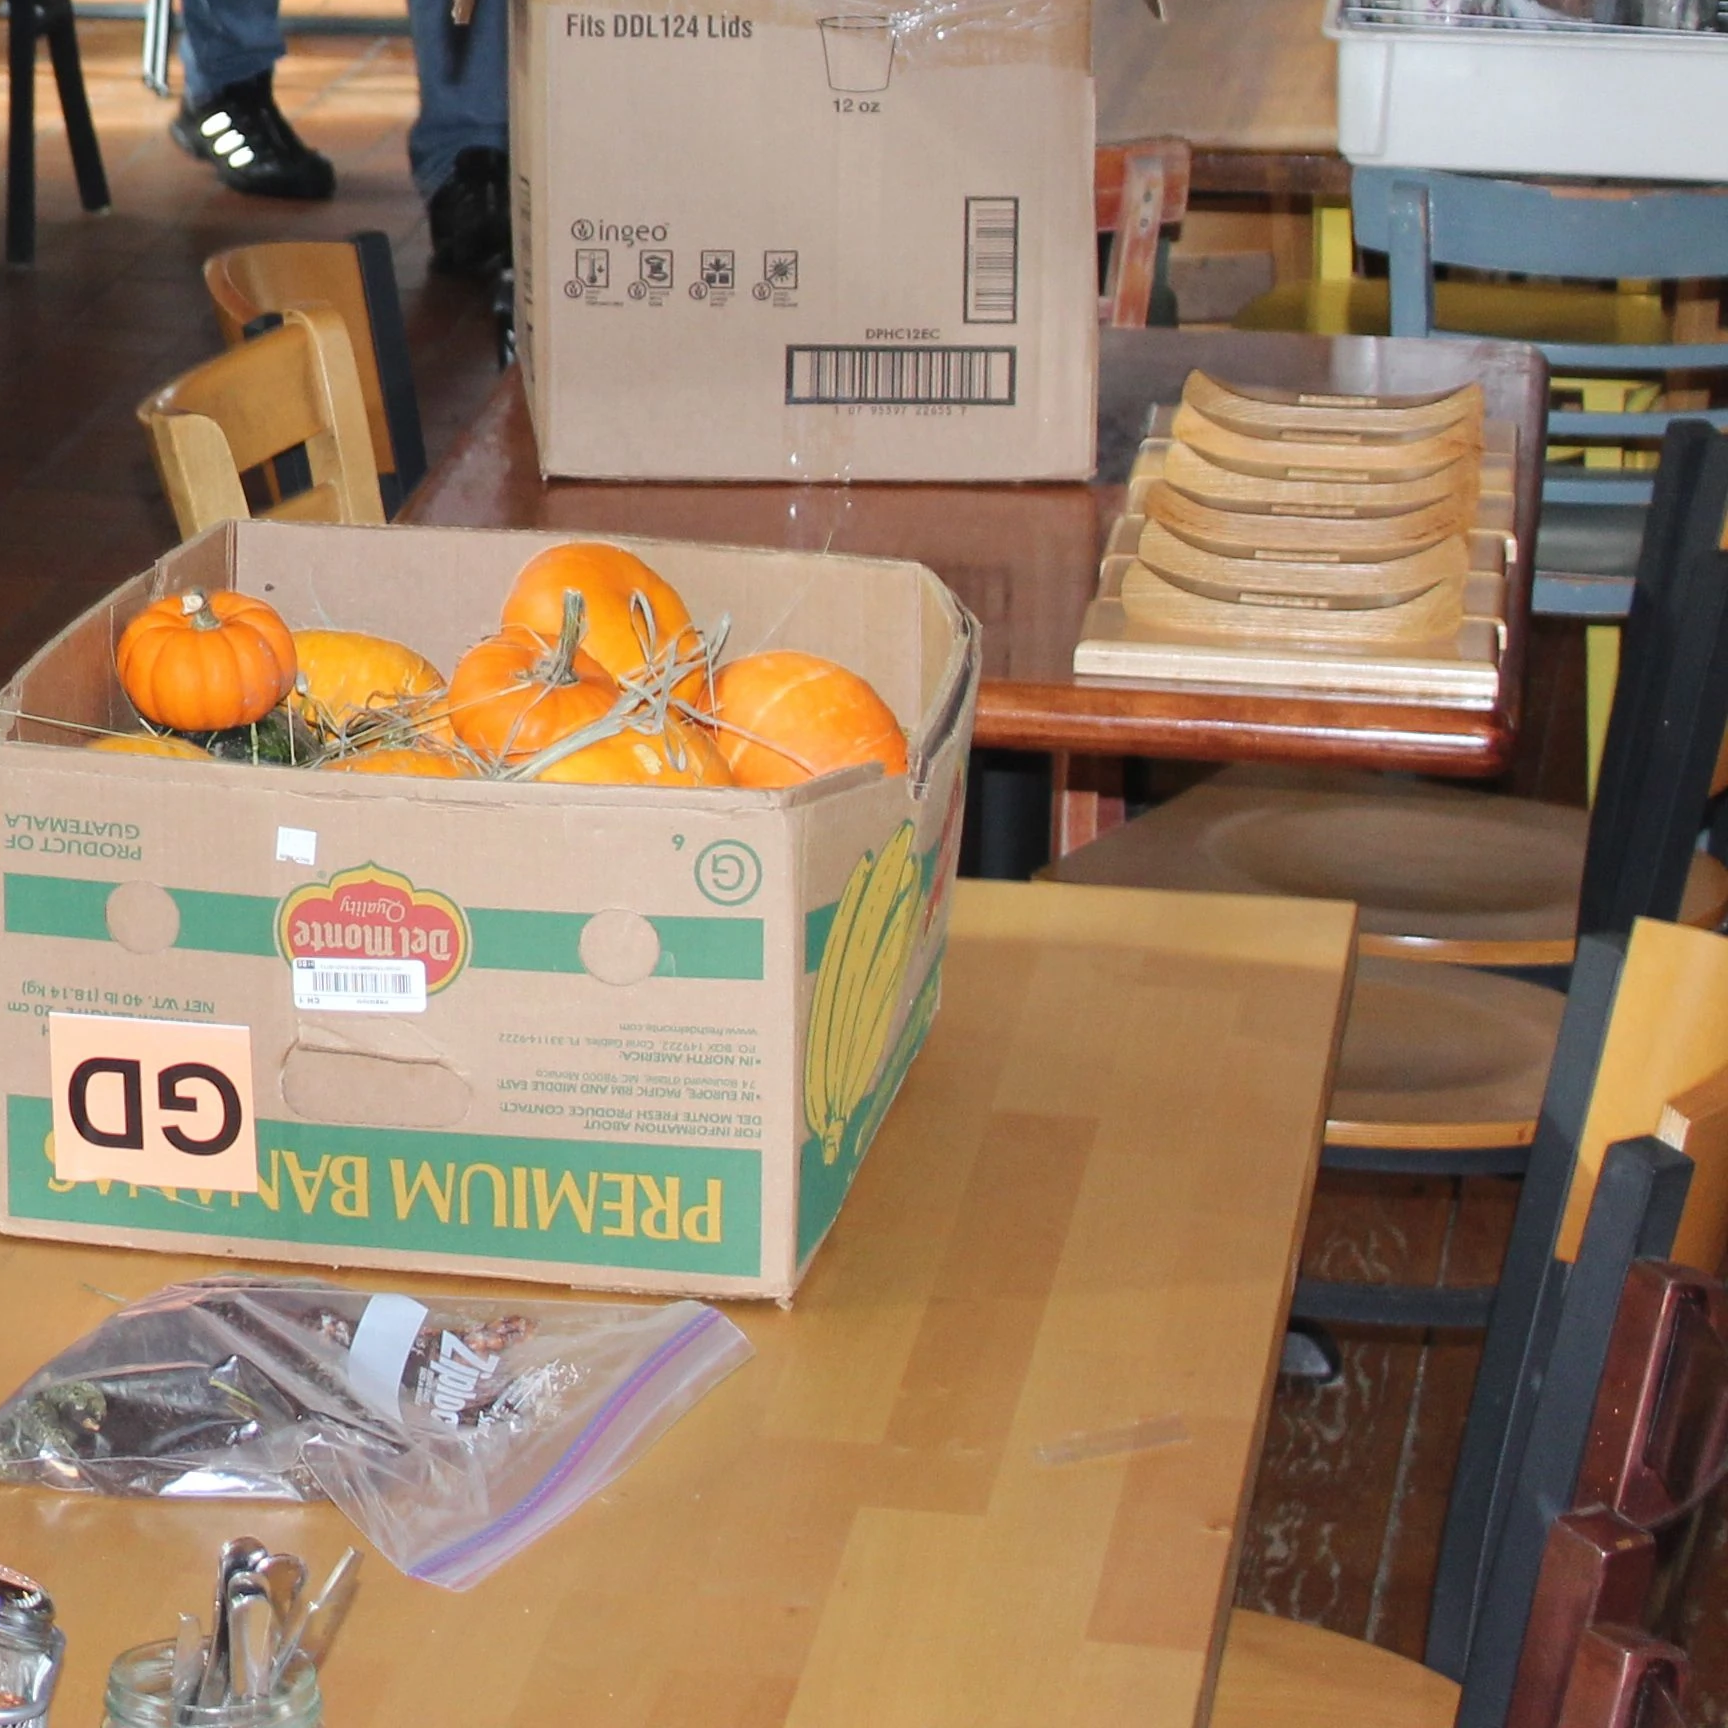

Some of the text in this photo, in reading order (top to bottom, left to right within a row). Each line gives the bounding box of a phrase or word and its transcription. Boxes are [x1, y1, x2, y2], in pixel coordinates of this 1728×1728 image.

[566, 13, 754, 39] Fits DDL124 Lids
[832, 99, 881, 113] 12 oz
[598, 219, 668, 247] ingeo
[864, 328, 941, 340] DPHC12EC
[4, 814, 141, 840] GUATEMALA
[5, 834, 143, 861] PRODUCT OF
[339, 895, 406, 923] Quality
[293, 920, 452, 961] Del Monte
[21, 980, 215, 1014] NET WT. 40 lb (18.14 kg)
[7, 1001, 30, 1014] cm
[565, 1036, 580, 1046] FL
[625, 1038, 655, 1049] Coral
[687, 1053, 735, 1065] NORTH
[496, 1078, 528, 1091] EAST:
[531, 1080, 577, 1093] MIDDLE
[579, 1083, 609, 1095] AND
[610, 1084, 633, 1096] RIM
[636, 1085, 682, 1098] PACIFIC
[66, 1055, 243, 1158] GD
[499, 1101, 763, 1126] DEL MONTE FRESH PRODUCE CONTACT:
[583, 1119, 763, 1139] FOR INFORMATION ABOUT
[390, 1158, 723, 1244] PREMIUM
